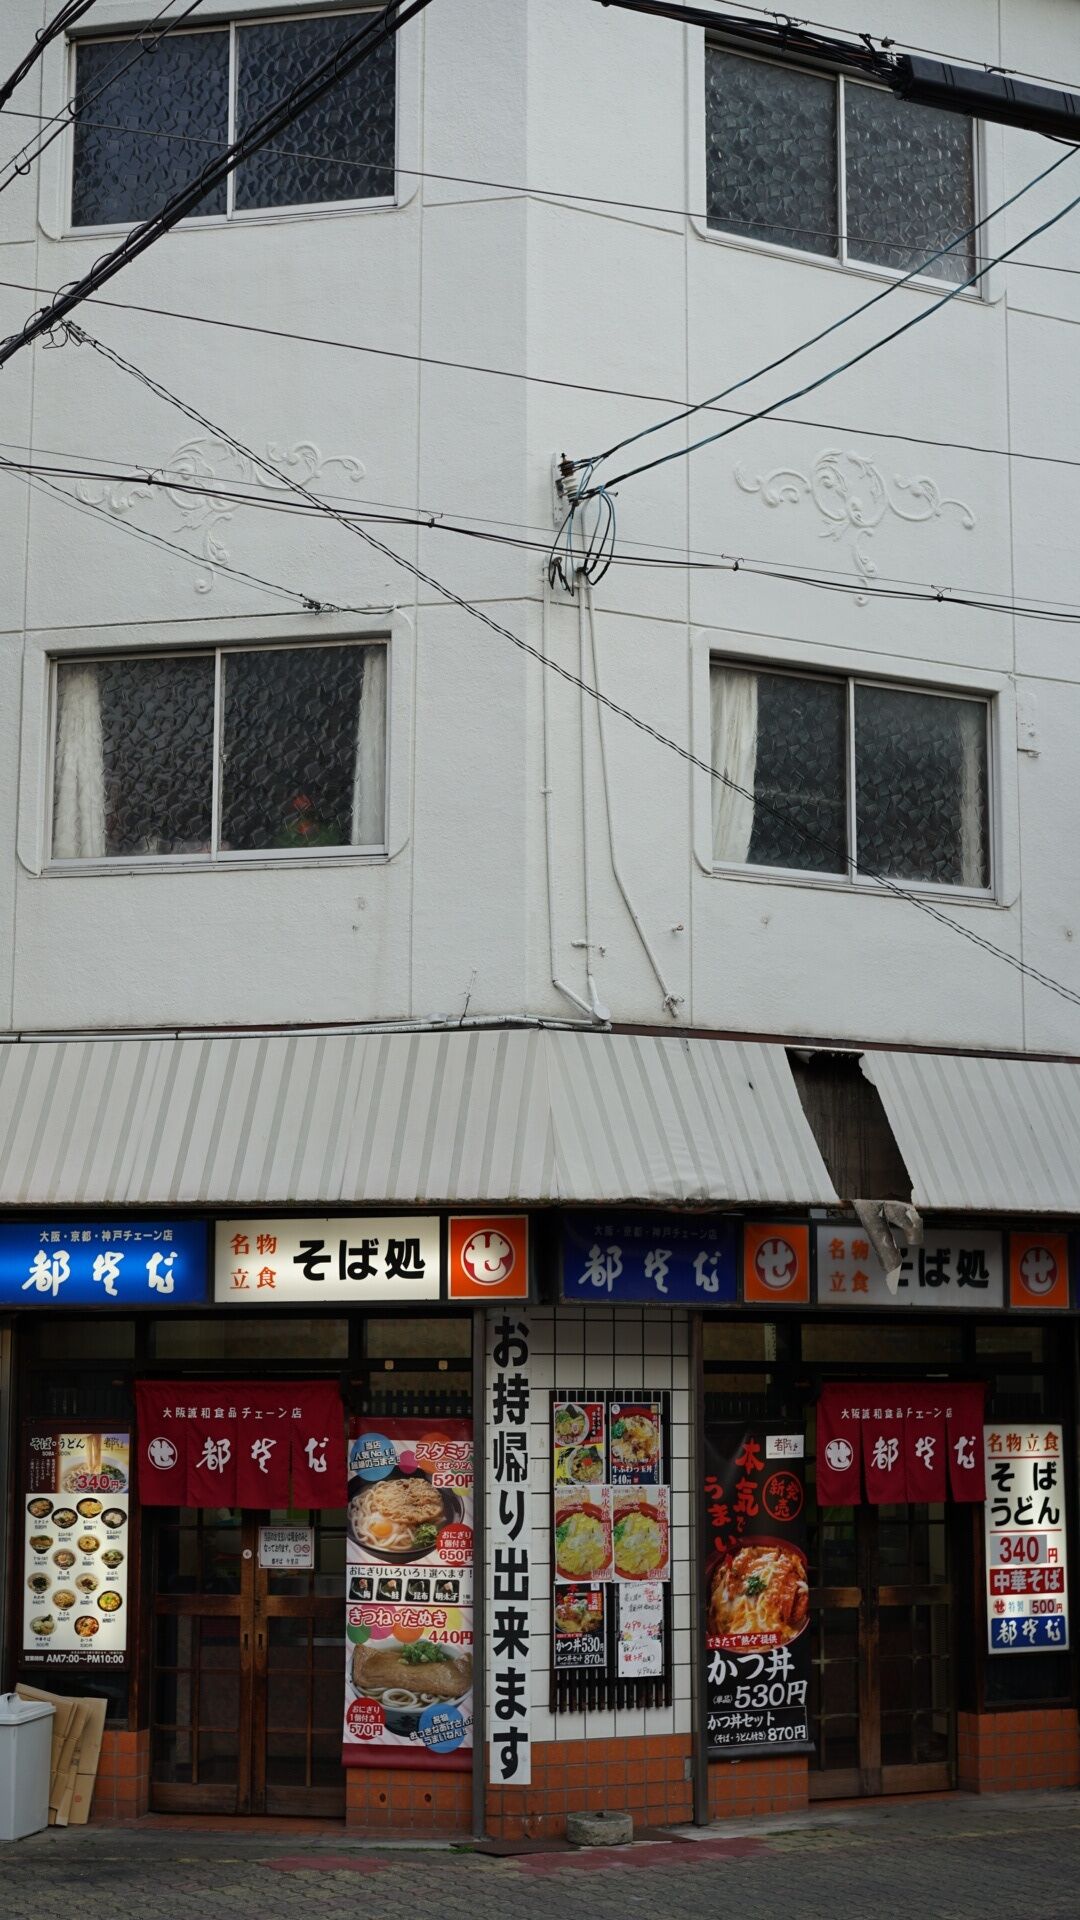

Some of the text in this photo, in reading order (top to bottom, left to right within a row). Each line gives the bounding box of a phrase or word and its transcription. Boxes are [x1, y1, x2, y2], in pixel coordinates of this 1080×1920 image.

[229, 1233, 277, 1256] 名物
[828, 1238, 869, 1260] 名物
[293, 1238, 425, 1280] そば処
[229, 1266, 277, 1289] 立食
[829, 1270, 869, 1293] 立食
[416, 1443, 473, 1460] スタミナ
[988, 1432, 1059, 1453] 名物立食
[991, 1461, 1057, 1492] そば
[991, 1495, 1060, 1526] うどん
[493, 1316, 530, 1780] お持帰り出来ます
[994, 1568, 1061, 1594] 中華そば
[556, 1638, 582, 1653] かつ丼
[707, 1646, 796, 1686] かつ丼
[734, 1680, 808, 1709] 530円
[349, 1724, 383, 1736] 570円
[708, 1712, 776, 1731] かつ丼セット
[768, 1724, 806, 1741] 870円
